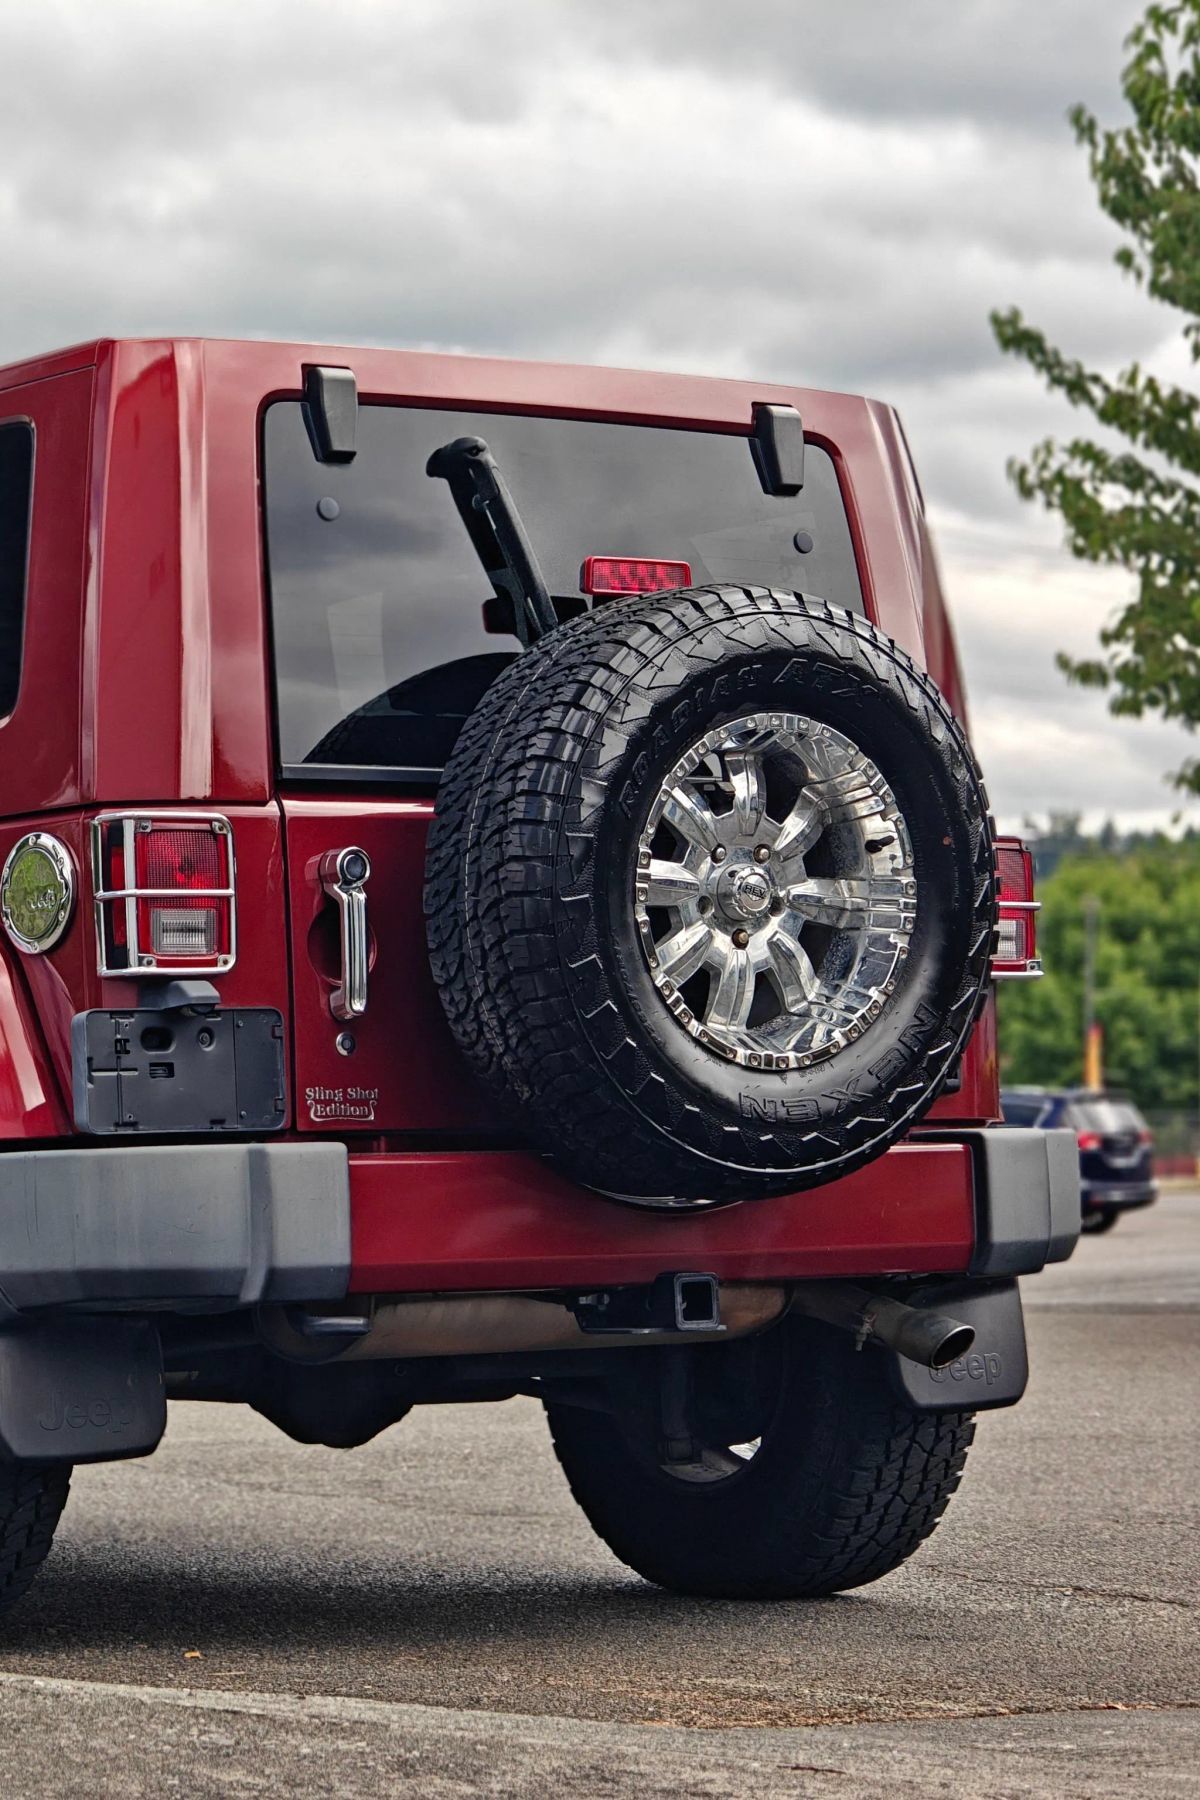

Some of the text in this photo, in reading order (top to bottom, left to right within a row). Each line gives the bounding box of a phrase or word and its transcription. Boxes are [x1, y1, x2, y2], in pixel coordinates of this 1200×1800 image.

[738, 1001, 942, 1123] NEXEN
[305, 1087, 379, 1101] Sling Shot
[316, 1103, 369, 1116] Edition
